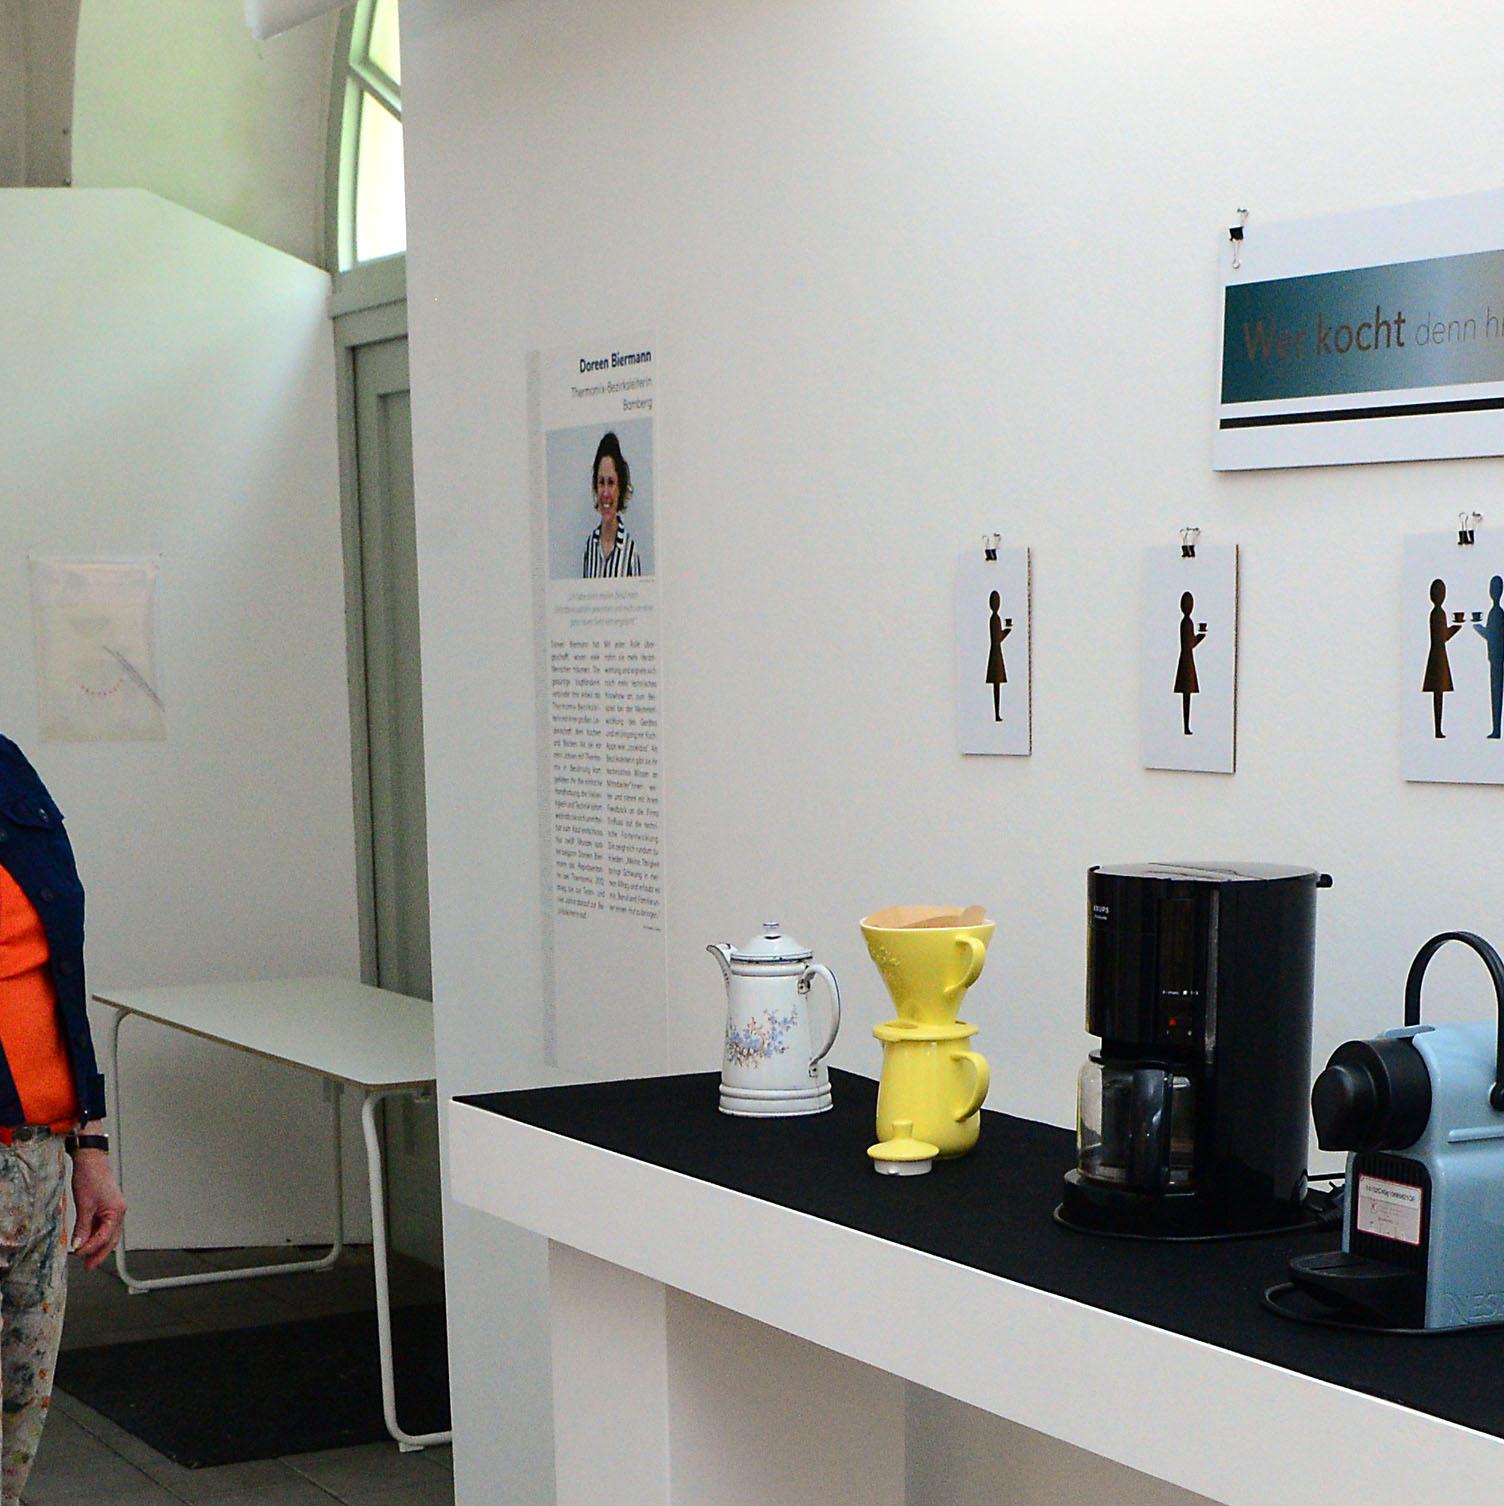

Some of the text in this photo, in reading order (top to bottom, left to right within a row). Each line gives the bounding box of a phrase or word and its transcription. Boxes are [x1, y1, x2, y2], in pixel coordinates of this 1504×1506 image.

[1243, 319, 1307, 361] Wer
[1316, 305, 1406, 354] kocht
[1414, 312, 1476, 347] denn
[579, 351, 652, 374] Doreen Biermann
